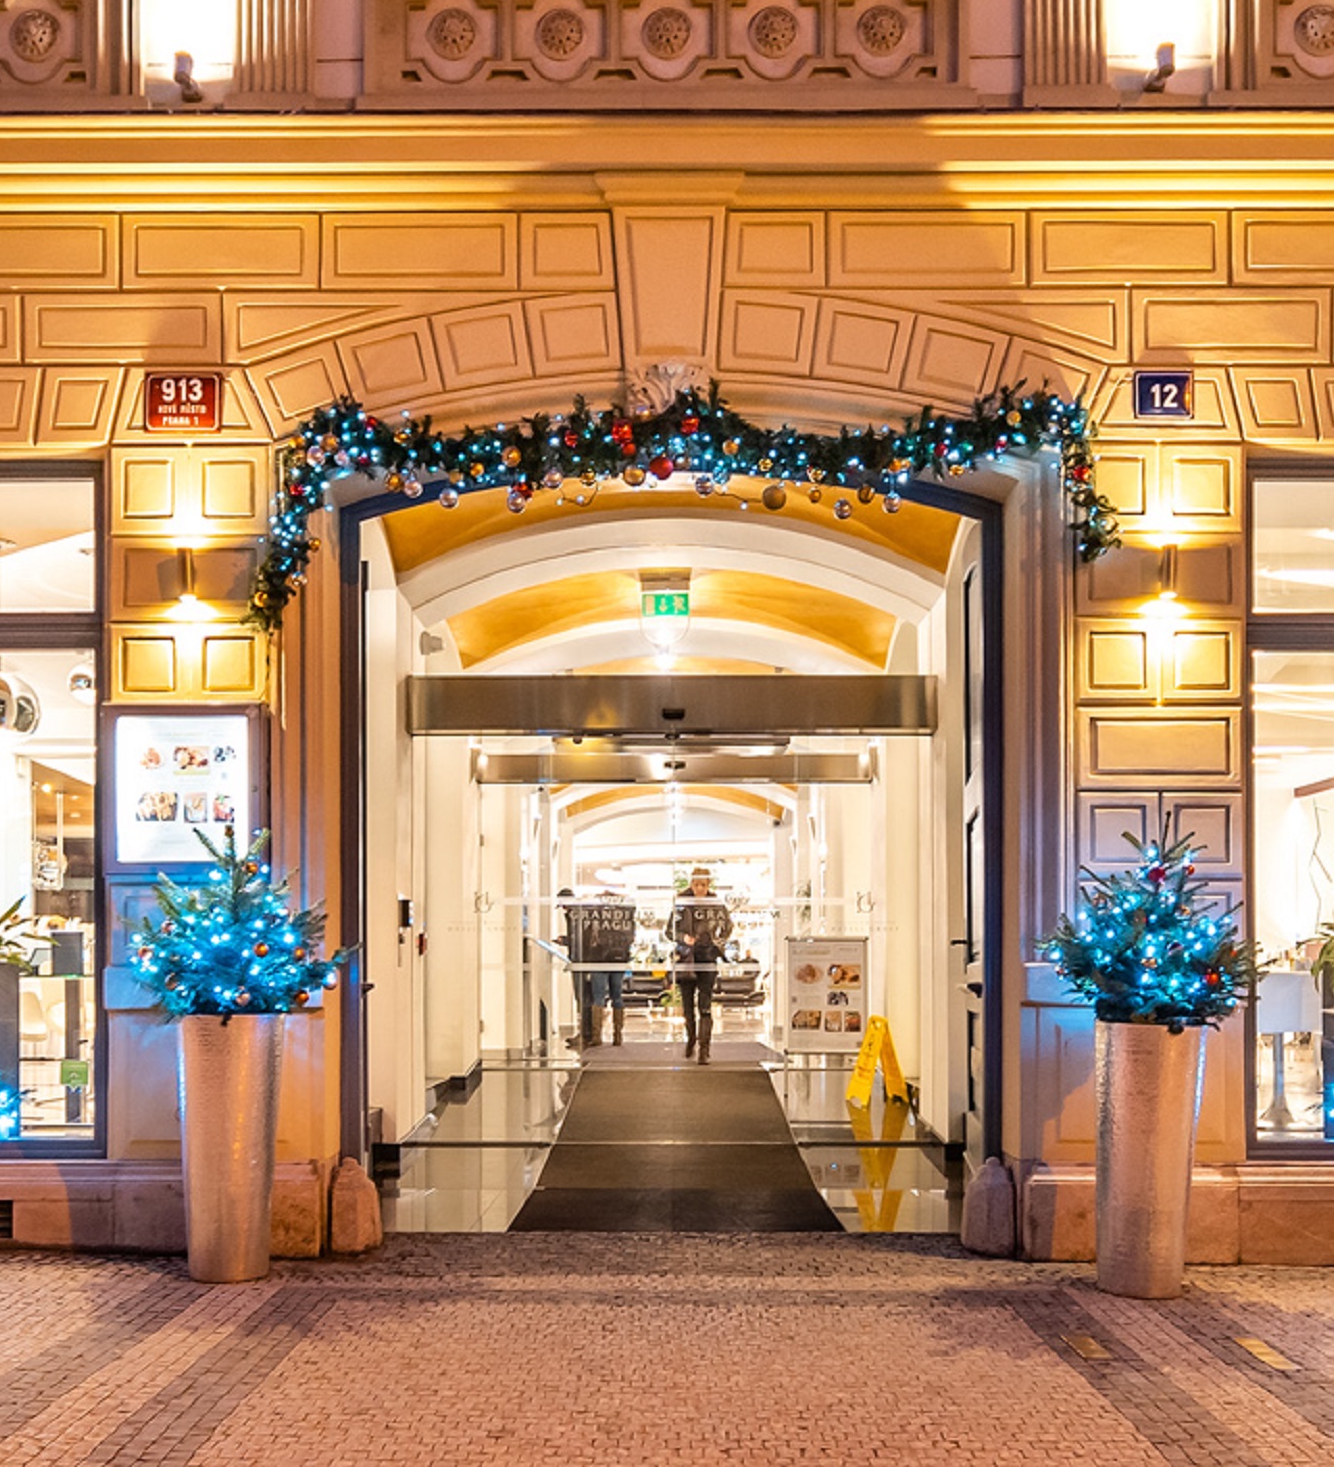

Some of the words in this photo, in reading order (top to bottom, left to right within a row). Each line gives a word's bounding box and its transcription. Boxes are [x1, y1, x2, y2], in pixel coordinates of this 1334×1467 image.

[161, 378, 203, 402] 913
[1150, 383, 1178, 408] 12
[193, 416, 199, 427] 1
[583, 920, 637, 931] PRAGU
